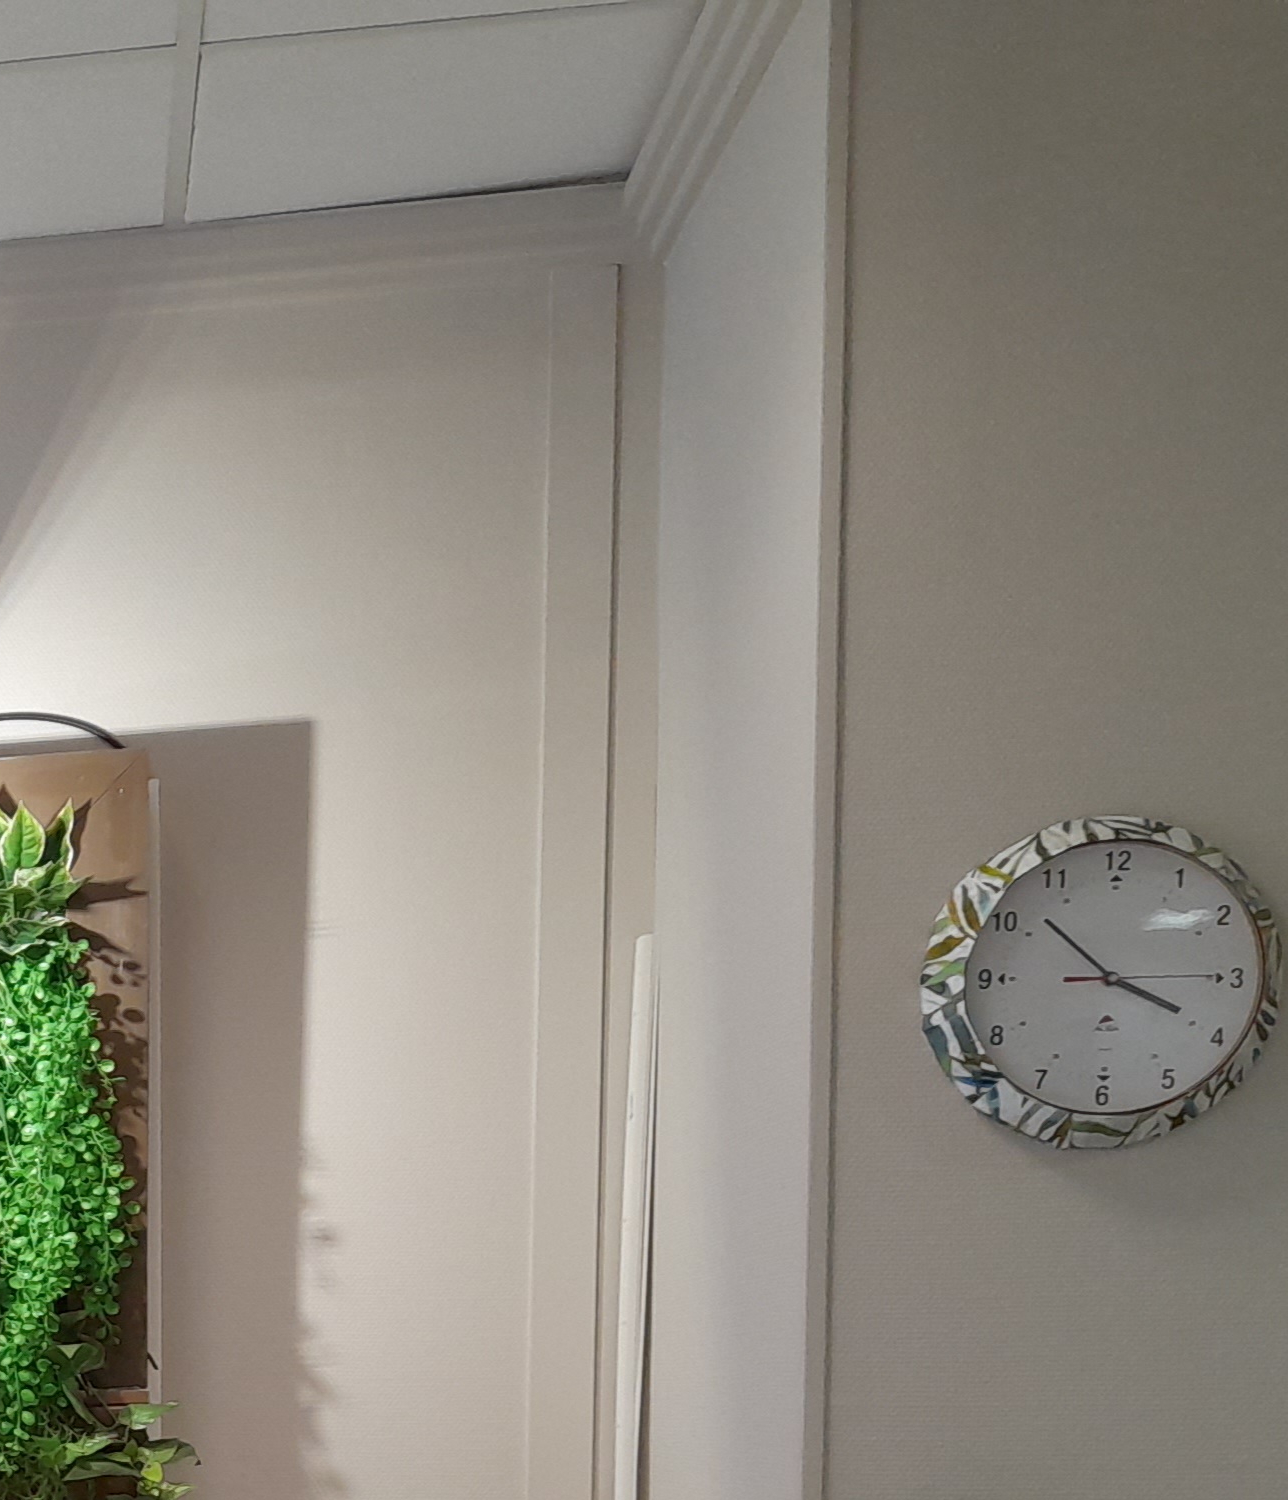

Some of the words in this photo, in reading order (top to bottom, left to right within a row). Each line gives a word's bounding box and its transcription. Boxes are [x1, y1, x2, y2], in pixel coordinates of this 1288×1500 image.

[1105, 850, 1131, 871] 12
[1042, 868, 1066, 889] 11
[1176, 868, 1184, 889] 1
[992, 911, 1018, 932] 10
[1216, 904, 1231, 926] 2
[978, 968, 992, 990] 9
[1230, 967, 1244, 989] 3
[989, 1025, 1004, 1046] 8
[1210, 1027, 1224, 1047] 4
[1034, 1069, 1048, 1090] 7
[1161, 1068, 1175, 1090] 5
[1095, 1085, 1109, 1106] 6
